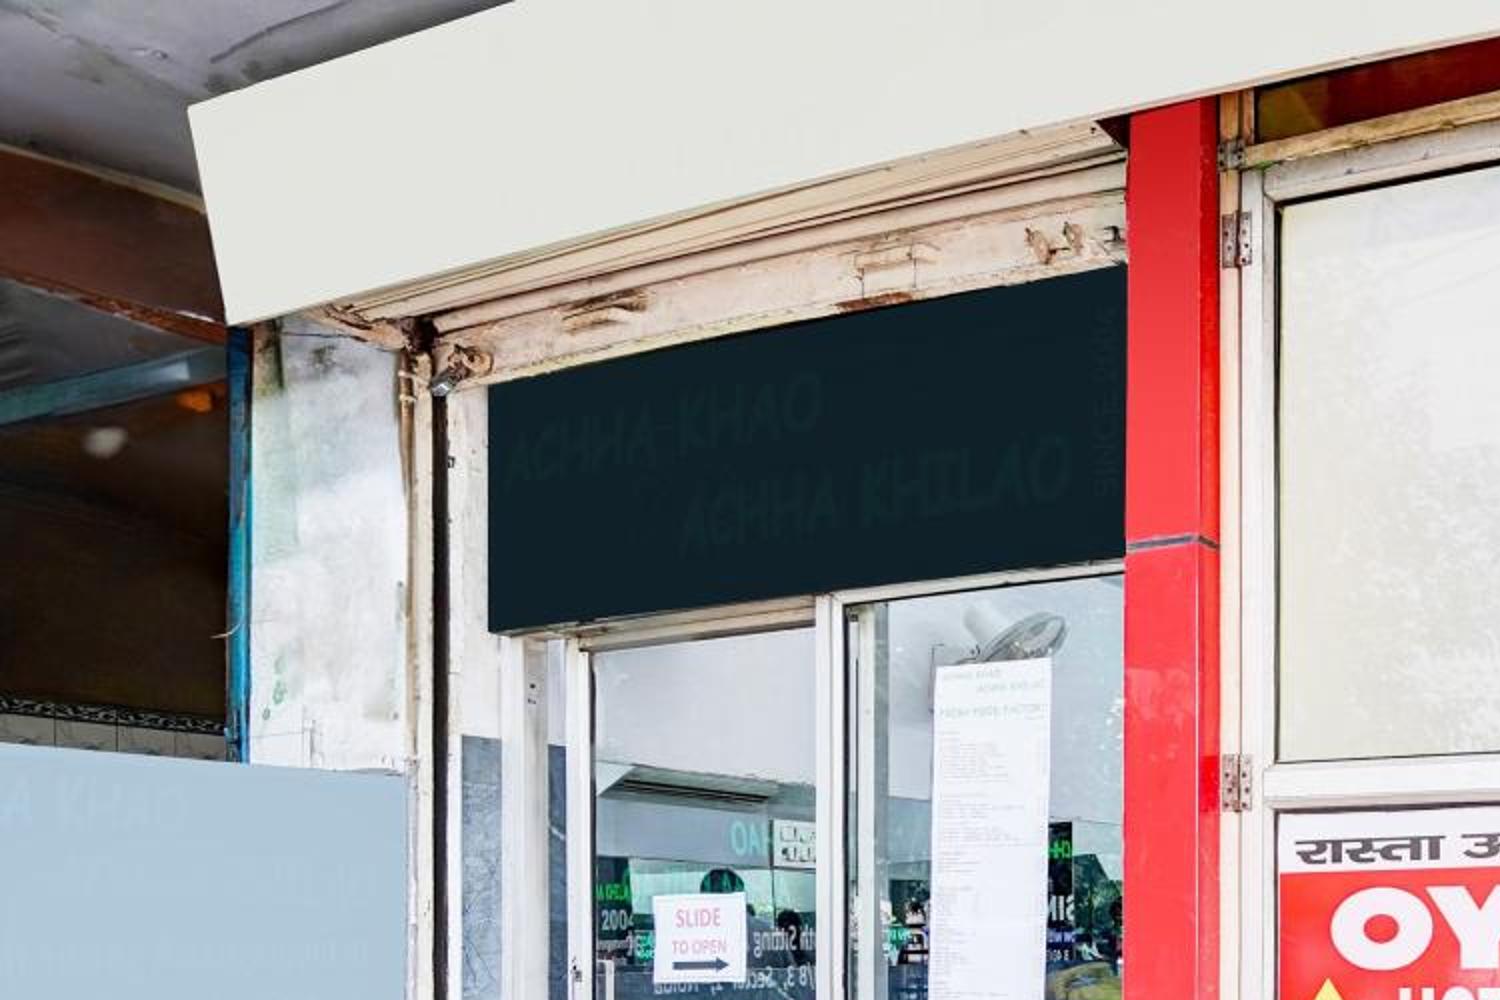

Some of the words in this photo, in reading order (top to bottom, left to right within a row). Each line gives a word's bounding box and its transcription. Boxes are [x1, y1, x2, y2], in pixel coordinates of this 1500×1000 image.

[1295, 834, 1446, 865] रास्ता
[675, 907, 721, 928] SLIDE
[672, 938, 689, 955] TO
[691, 937, 727, 955] OPEN
